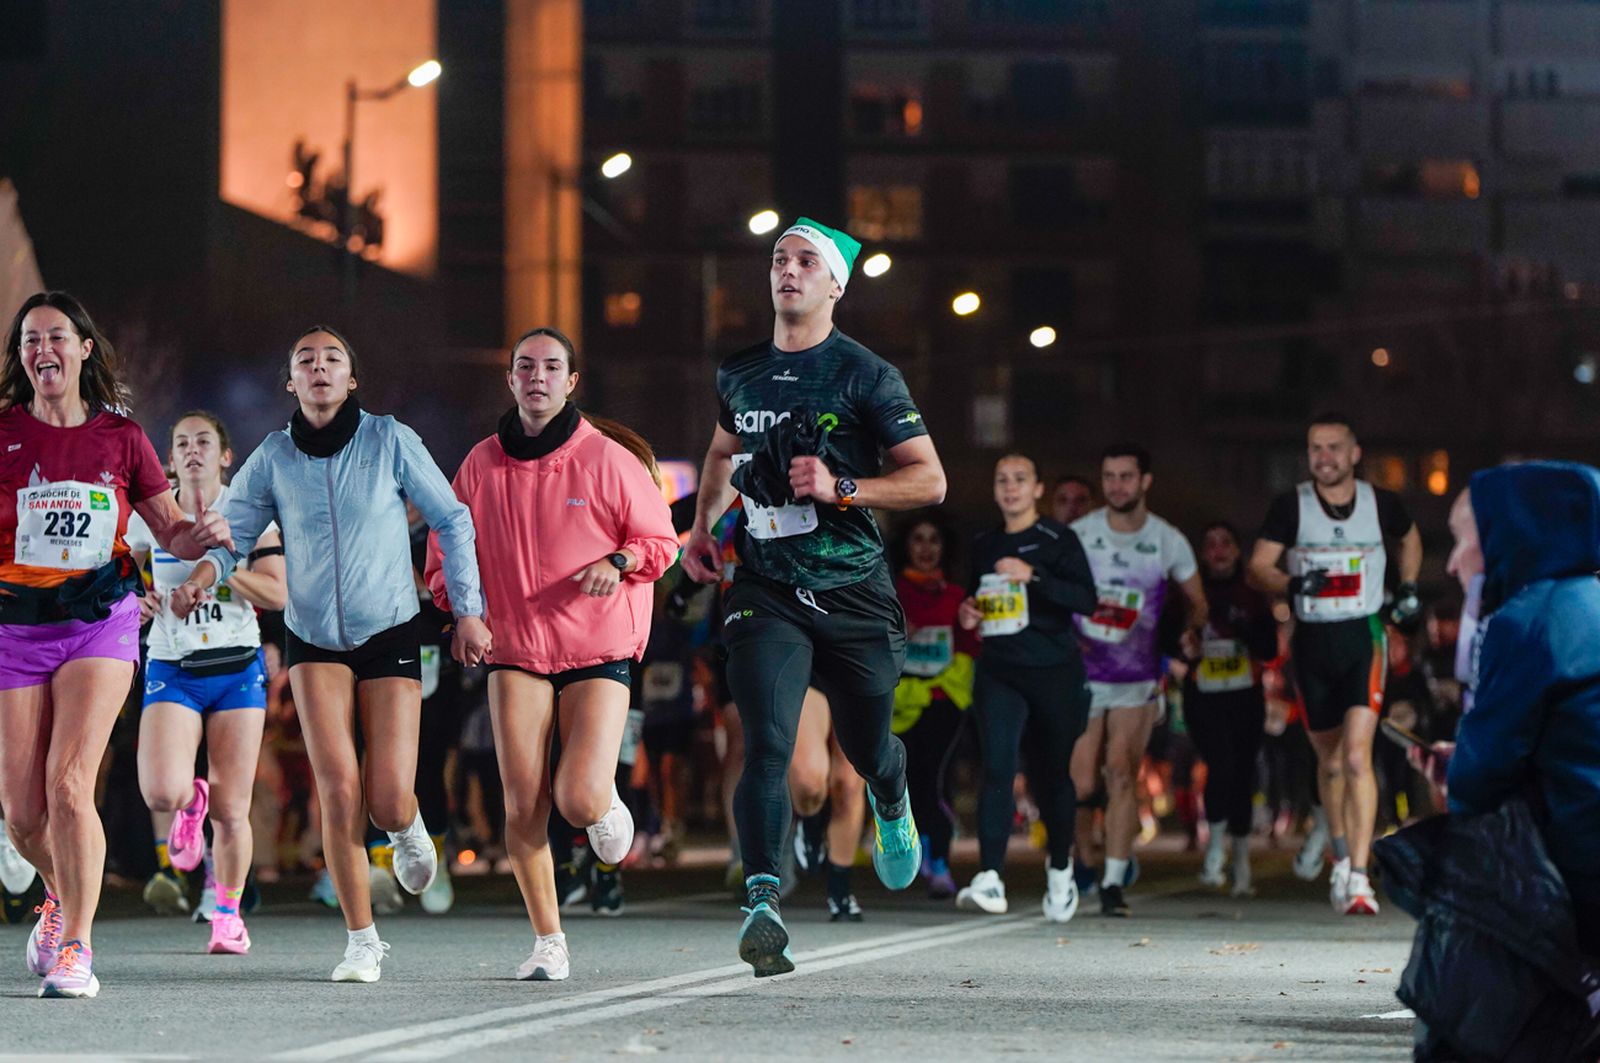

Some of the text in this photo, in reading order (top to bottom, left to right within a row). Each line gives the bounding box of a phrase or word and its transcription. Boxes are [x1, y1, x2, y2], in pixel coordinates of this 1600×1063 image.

[40, 490, 68, 499] NOCHE
[70, 490, 81, 499] DE
[28, 501, 48, 510] SAN
[567, 498, 586, 506] FILA
[44, 511, 91, 538] 232
[50, 539, 82, 547] MERCEDES
